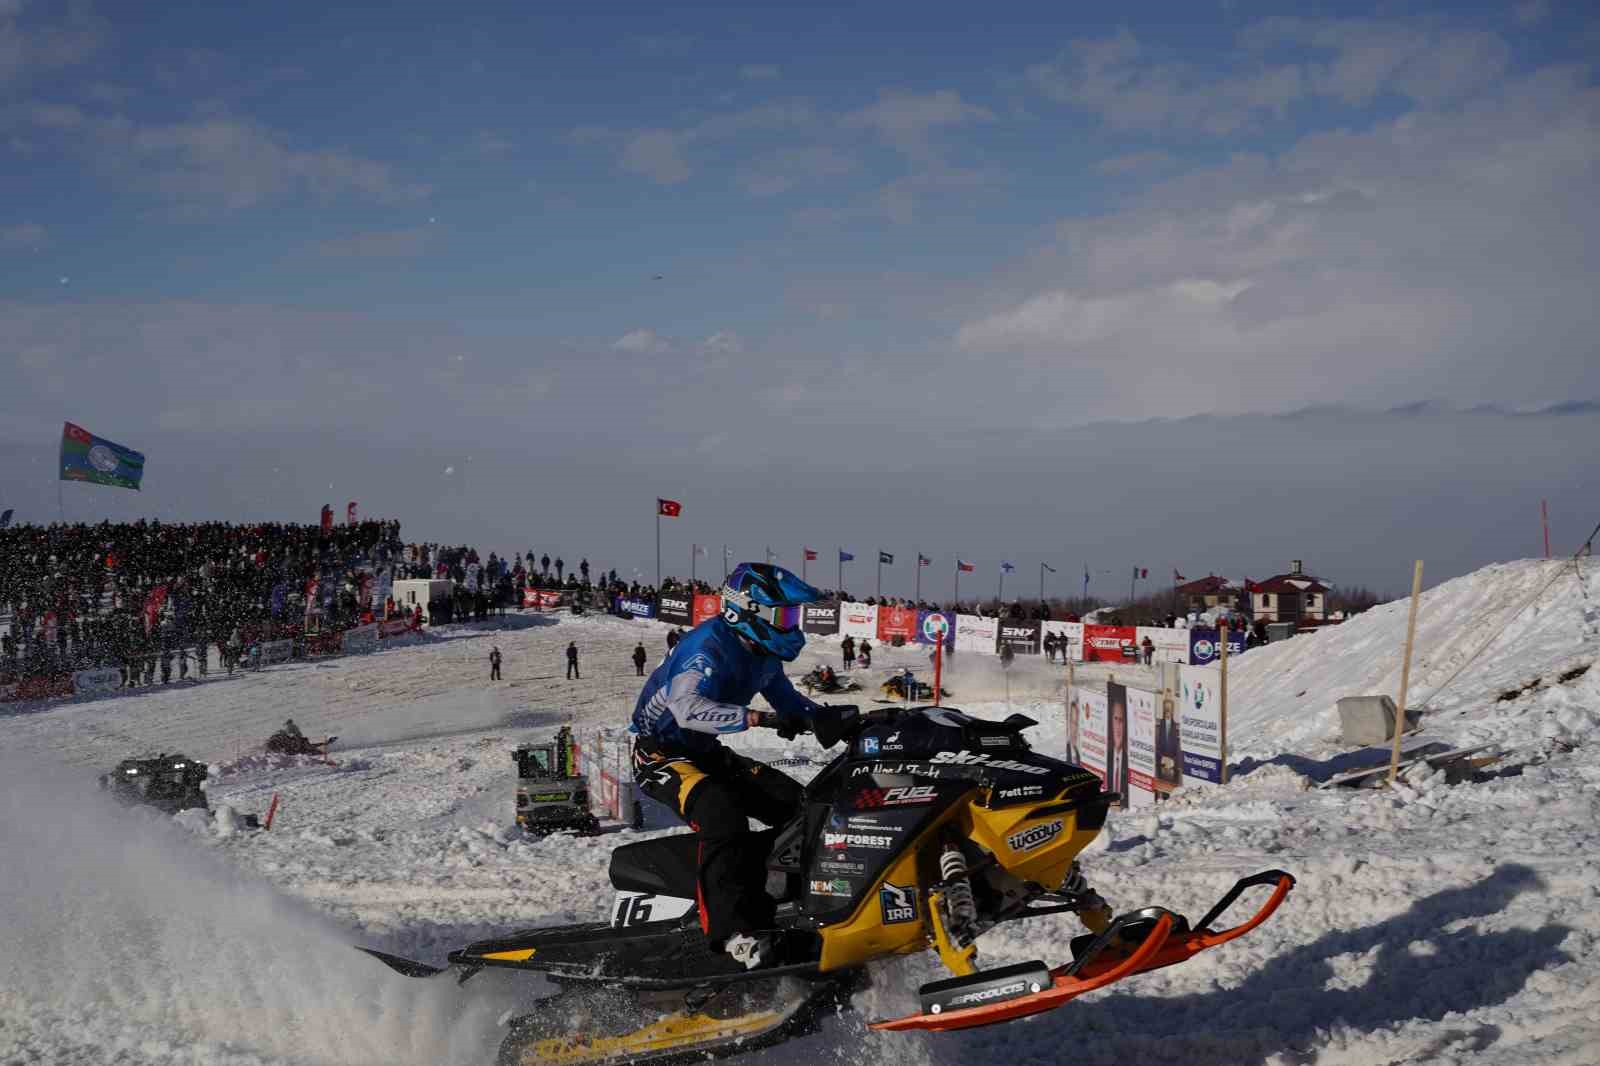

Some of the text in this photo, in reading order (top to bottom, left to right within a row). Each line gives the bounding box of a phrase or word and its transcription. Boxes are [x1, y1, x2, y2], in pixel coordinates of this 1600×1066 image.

[806, 608, 836, 617] SNX
[1215, 641, 1241, 652] RZE
[883, 785, 939, 801] FUEL
[614, 893, 656, 926] 16
